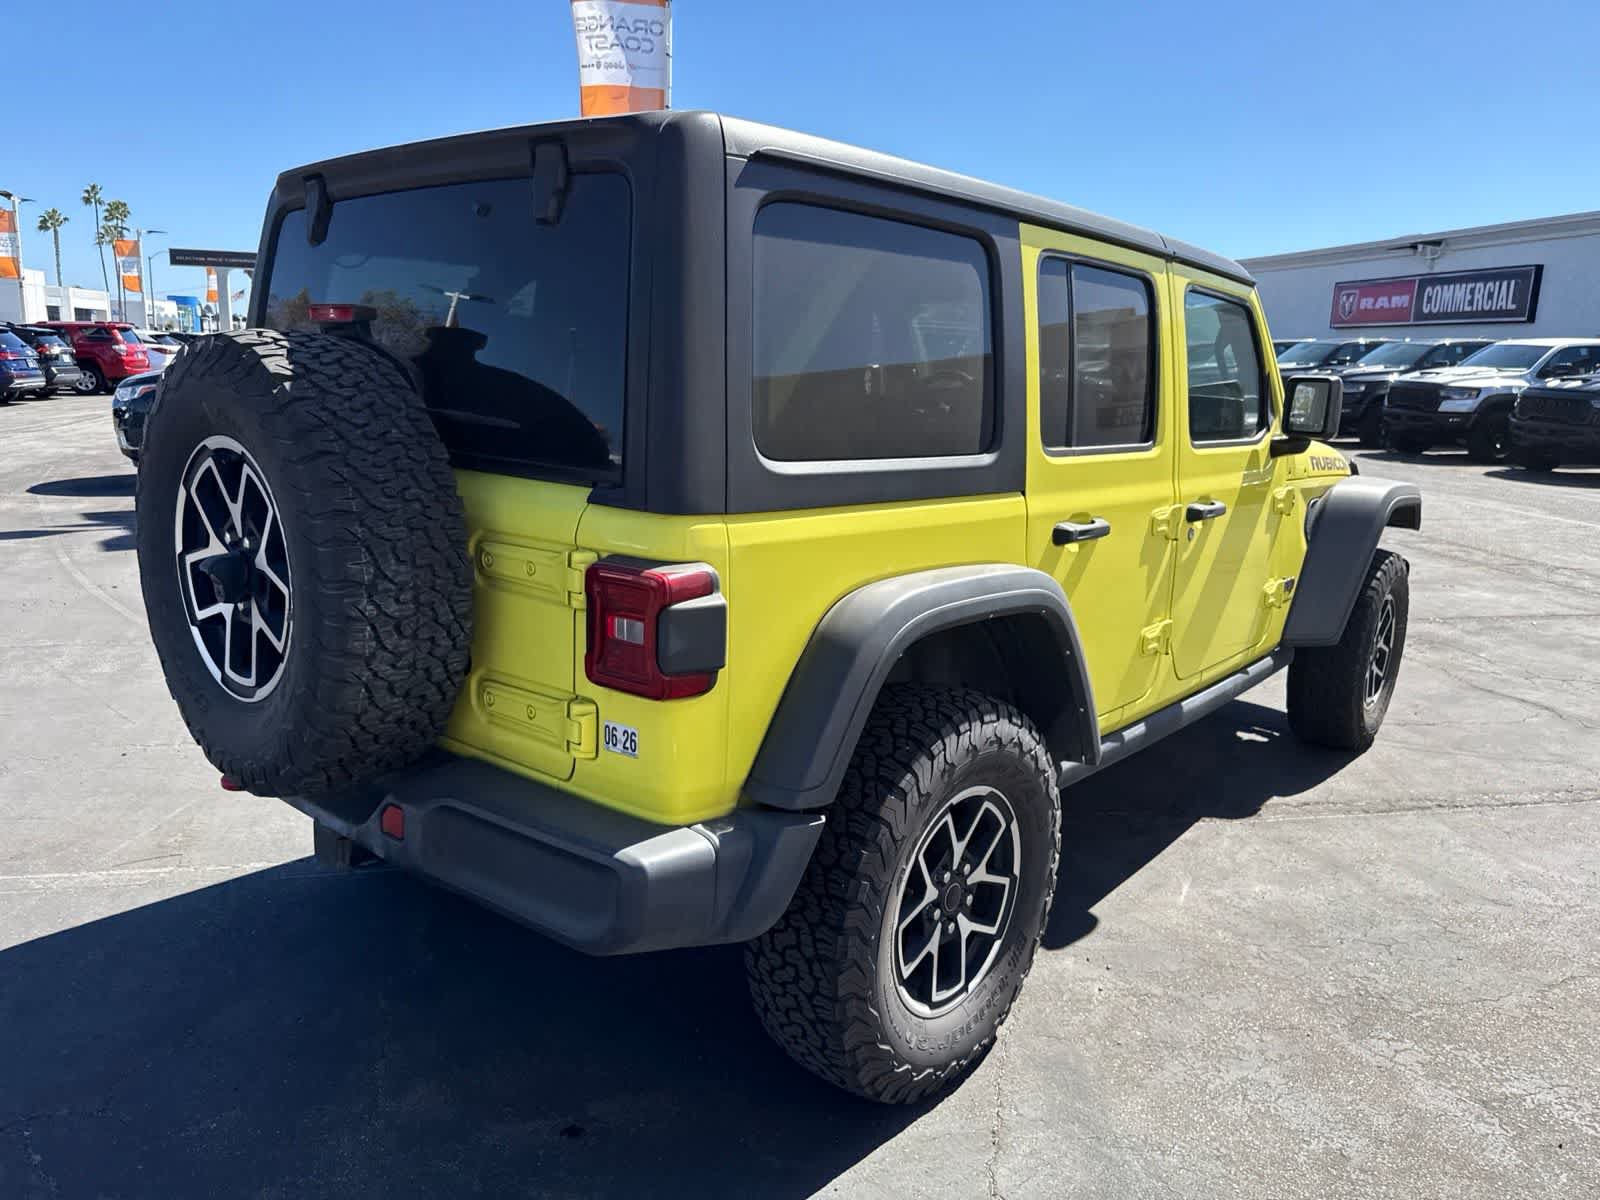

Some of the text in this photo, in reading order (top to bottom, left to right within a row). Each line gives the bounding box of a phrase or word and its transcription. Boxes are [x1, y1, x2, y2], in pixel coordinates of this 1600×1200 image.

[1359, 279, 1517, 314] RAM COMMERCIAL
[604, 724, 637, 753] 06 26
